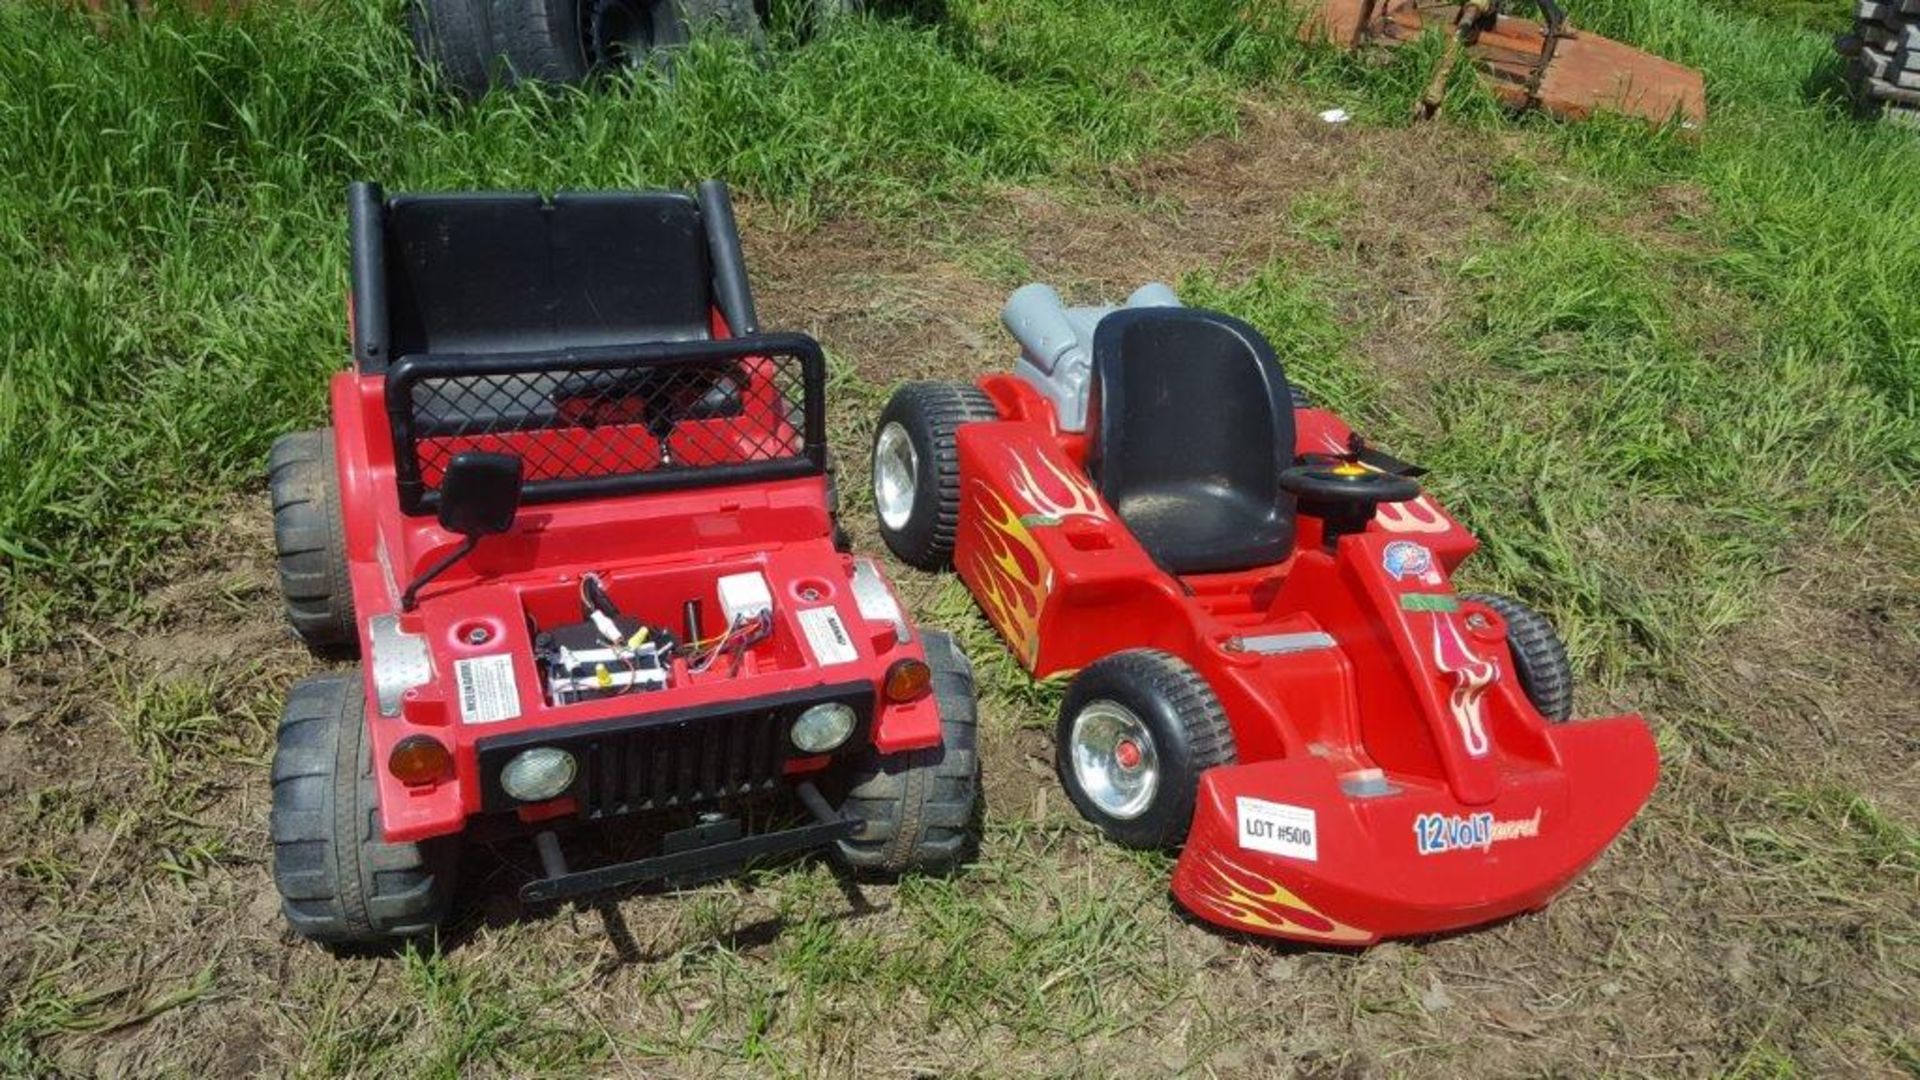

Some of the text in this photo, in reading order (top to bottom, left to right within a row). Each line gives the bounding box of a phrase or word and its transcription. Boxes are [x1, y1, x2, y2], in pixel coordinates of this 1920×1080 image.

[1245, 818, 1312, 846] LOT #500
[1415, 814, 1446, 853] 12
[1446, 814, 1492, 847] VOLT
